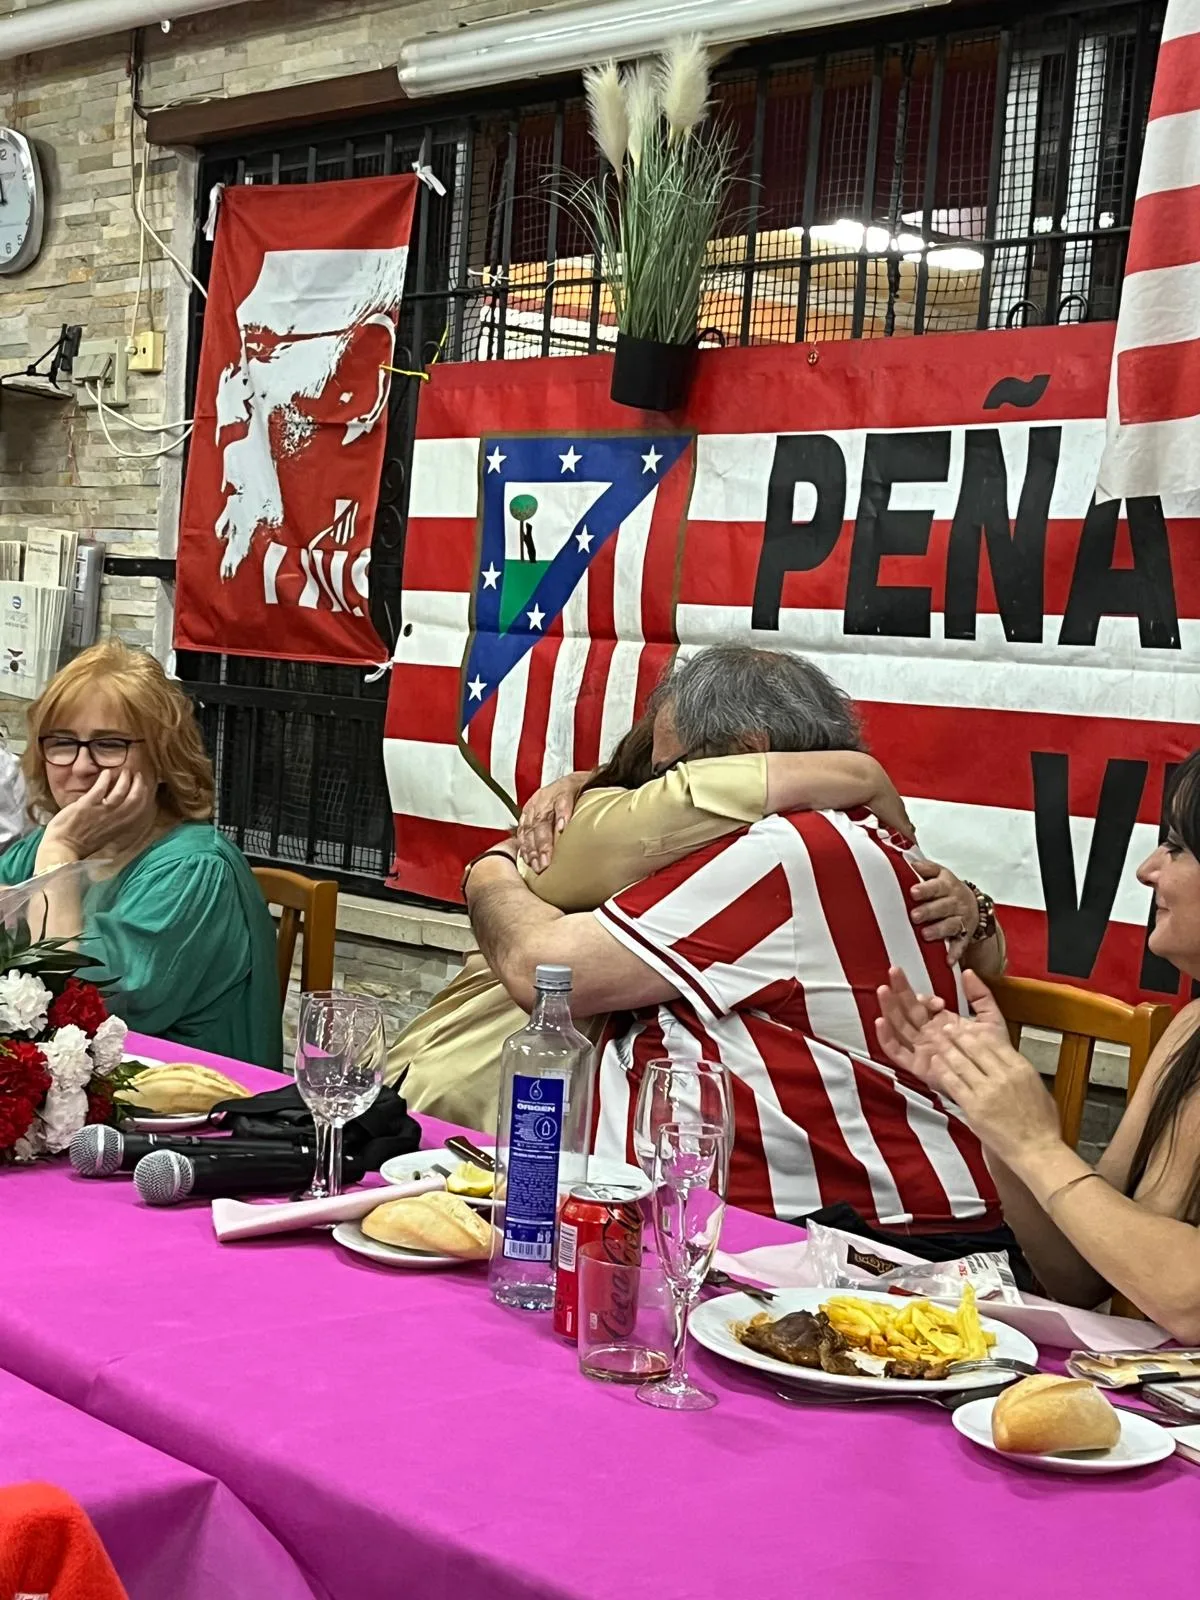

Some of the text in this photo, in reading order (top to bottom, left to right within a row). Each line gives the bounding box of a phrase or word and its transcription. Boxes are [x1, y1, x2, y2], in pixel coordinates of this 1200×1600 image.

[5, 242, 12, 254] 6
[751, 374, 1182, 650] PEÑA
[516, 1102, 556, 1113] ORIGEN
